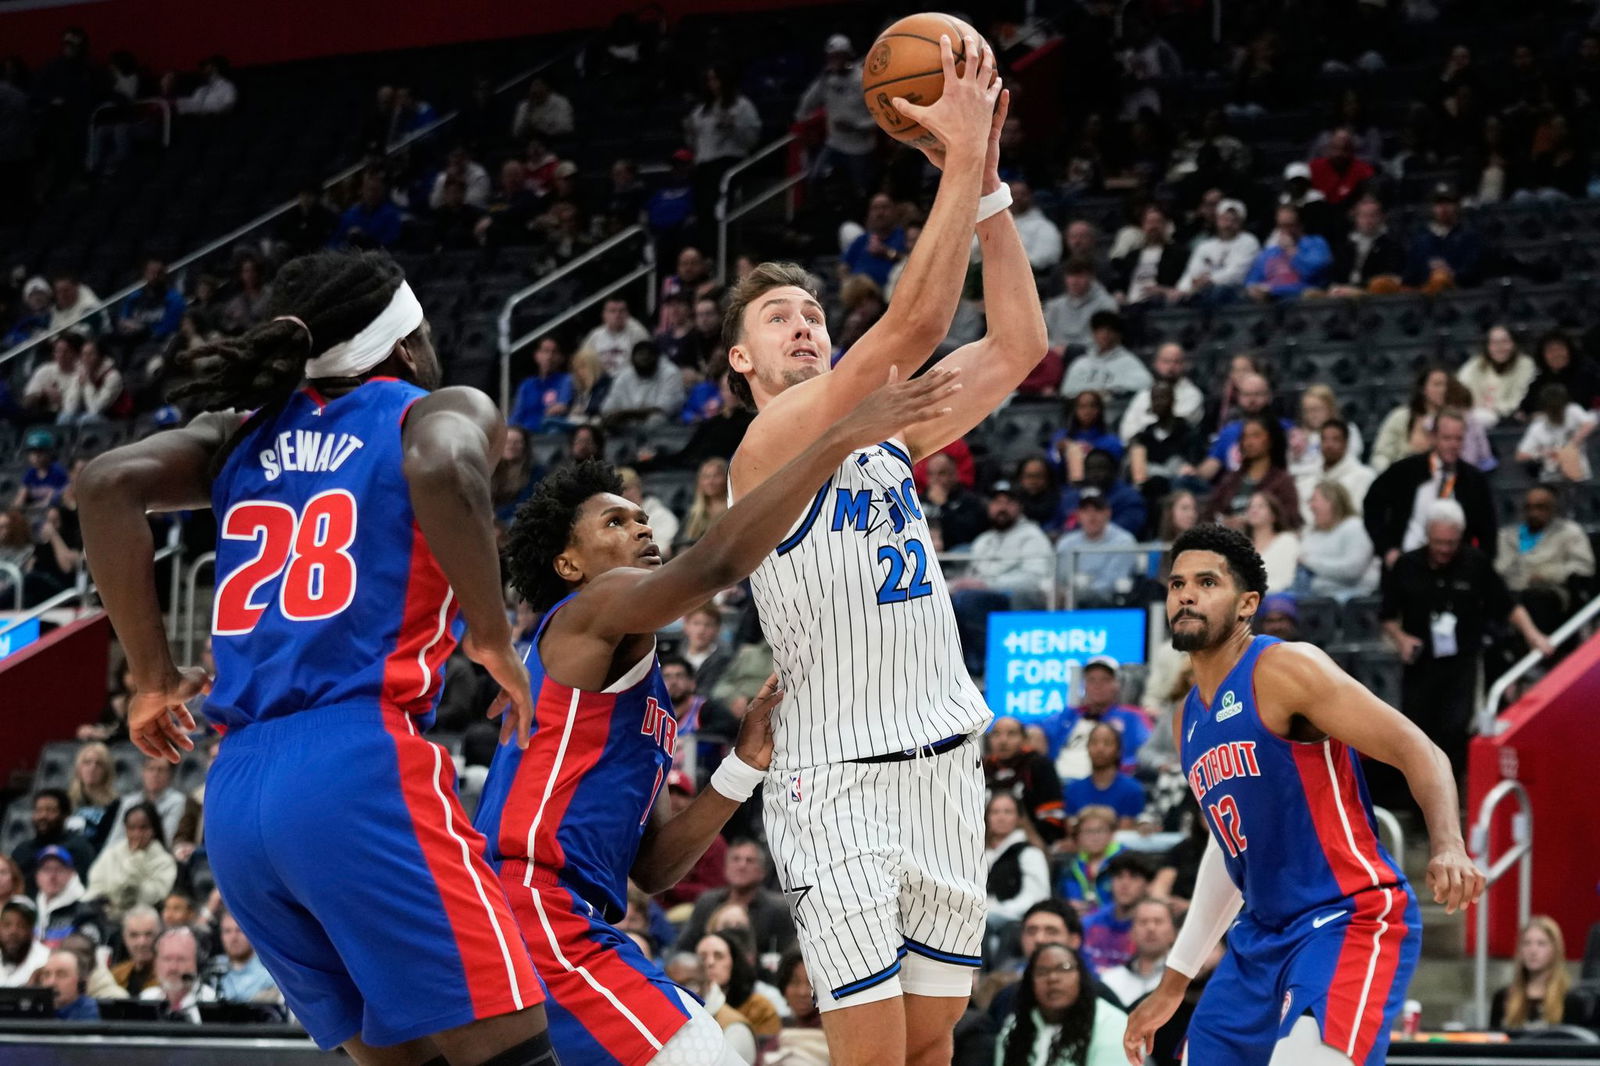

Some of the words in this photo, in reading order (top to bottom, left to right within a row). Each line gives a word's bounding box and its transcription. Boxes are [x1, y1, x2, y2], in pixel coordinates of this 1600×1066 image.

[259, 430, 364, 482] SEWAT
[831, 477, 923, 539] MIC
[211, 488, 357, 636] 28
[877, 538, 933, 605] 22
[1003, 628, 1108, 655] HENRY
[1208, 794, 1248, 858] 12
